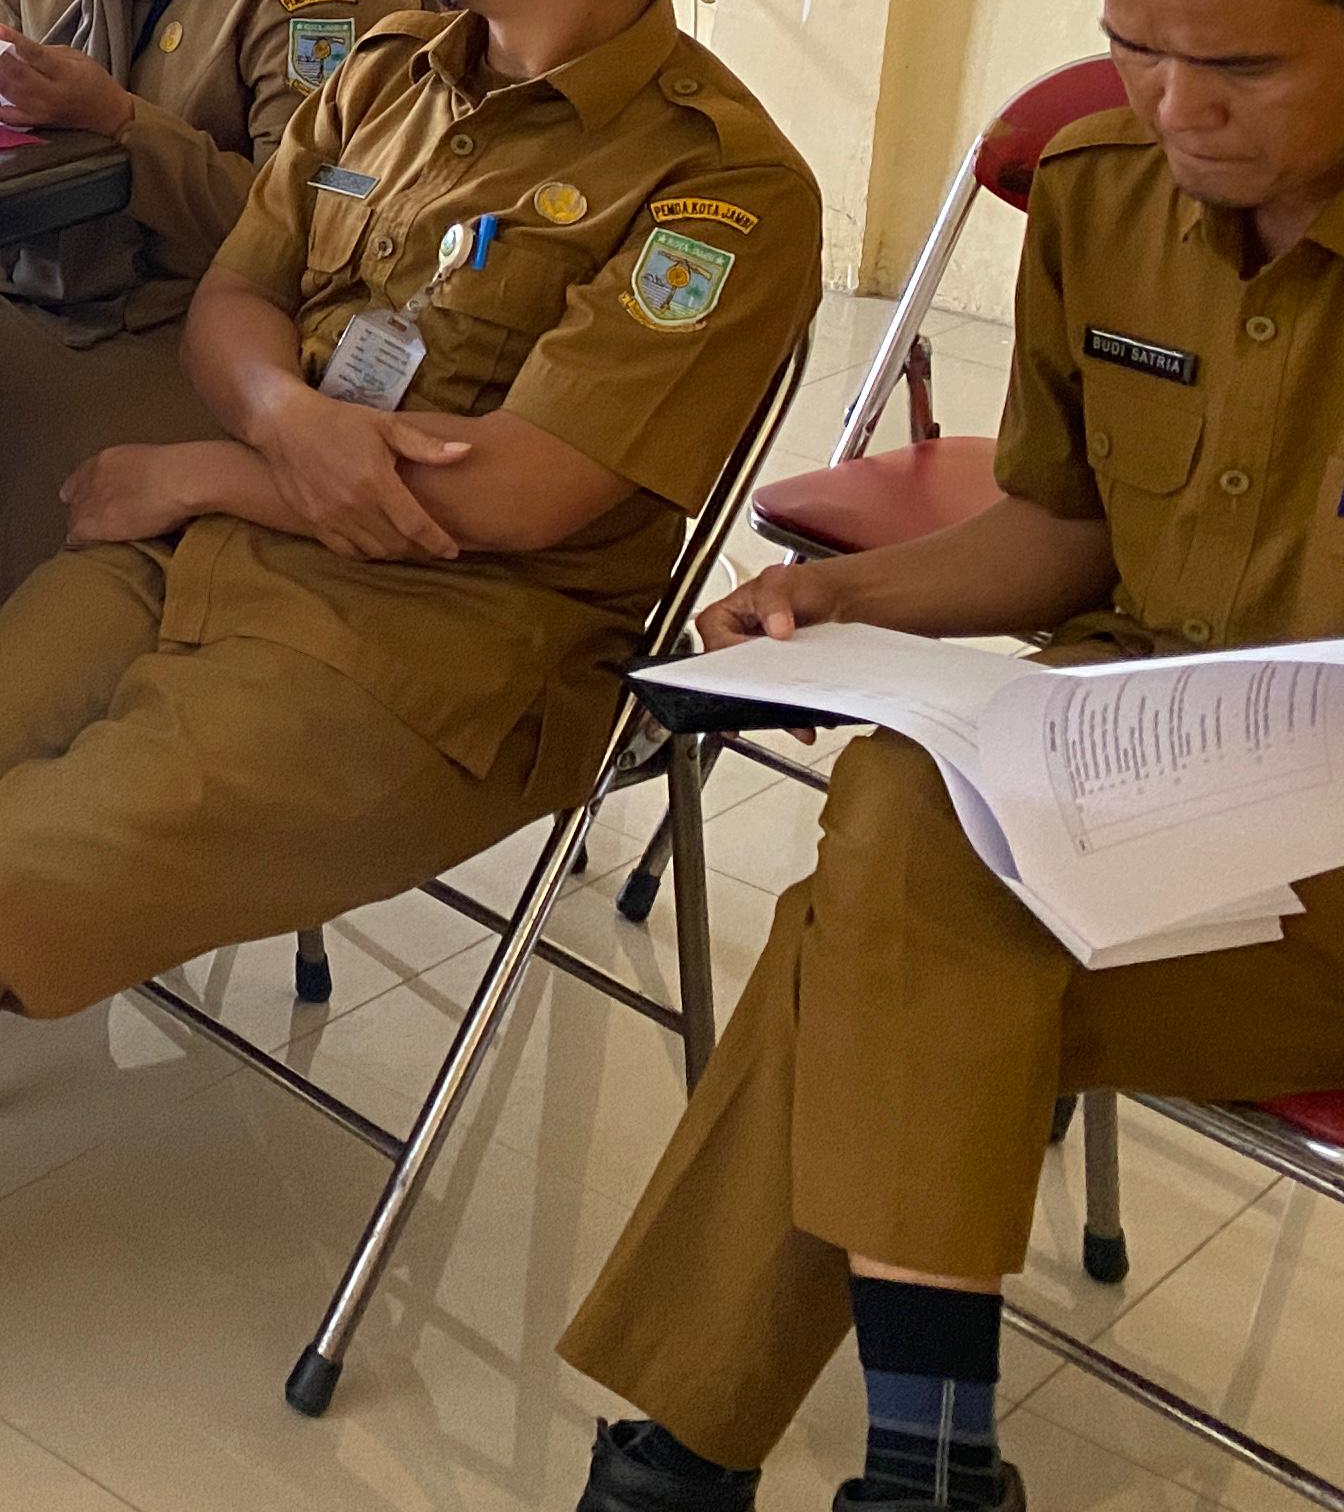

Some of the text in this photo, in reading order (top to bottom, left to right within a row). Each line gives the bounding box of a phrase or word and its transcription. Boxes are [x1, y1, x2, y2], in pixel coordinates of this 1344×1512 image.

[653, 200, 688, 219] PEMDA
[691, 202, 720, 217] KOTA
[1092, 336, 1180, 374] BUDI SATRIA
